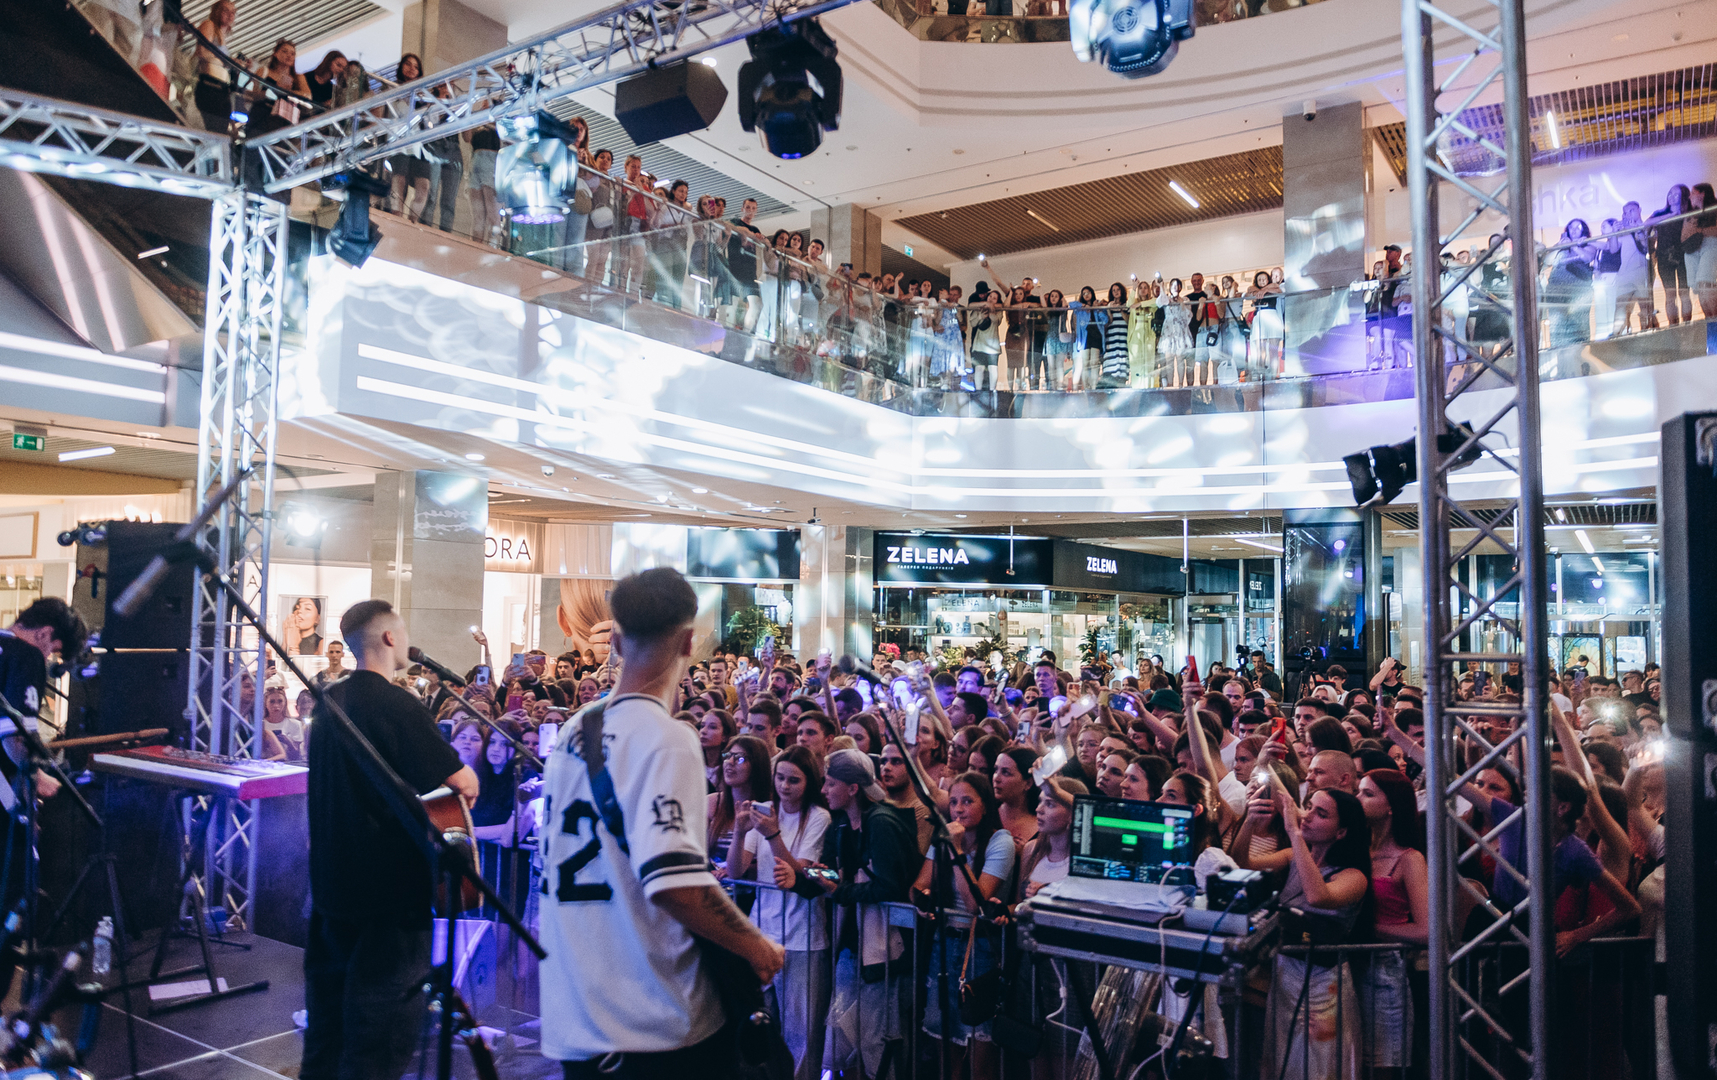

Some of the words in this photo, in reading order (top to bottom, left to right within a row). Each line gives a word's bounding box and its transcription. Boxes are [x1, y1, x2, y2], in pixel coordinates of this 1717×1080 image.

[485, 537, 531, 560] ORA
[886, 546, 970, 565] ZELENA
[1086, 556, 1118, 574] ZELENA
[246, 574, 260, 589] A
